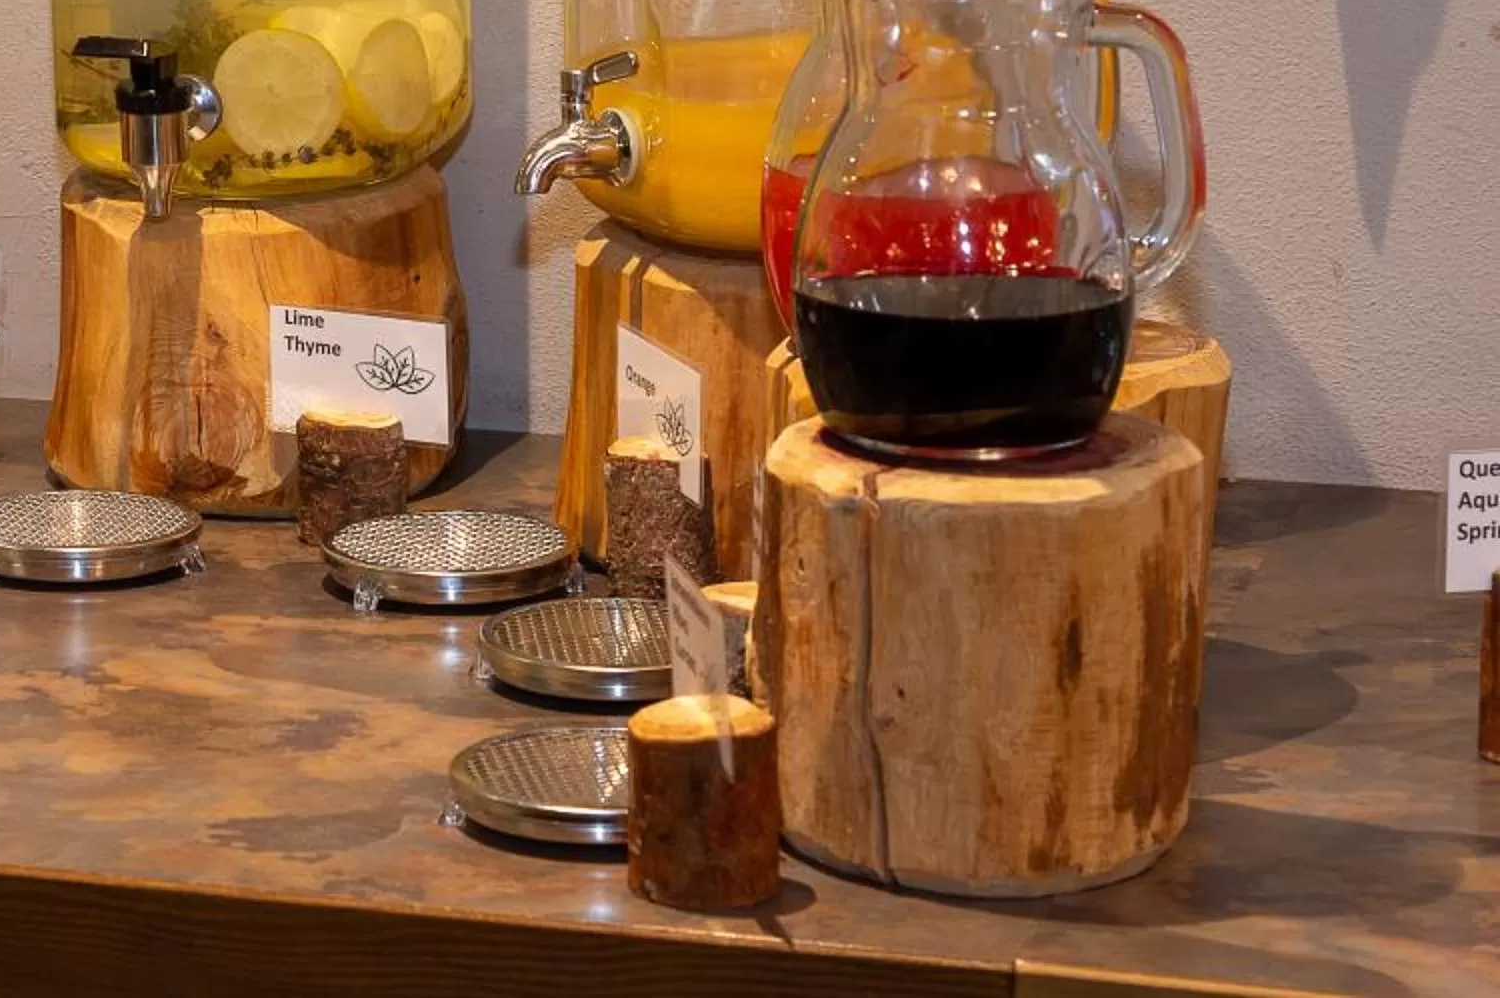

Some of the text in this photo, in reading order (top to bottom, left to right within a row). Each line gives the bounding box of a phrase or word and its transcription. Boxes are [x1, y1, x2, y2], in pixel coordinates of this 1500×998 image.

[284, 309, 325, 329] Lime
[283, 335, 341, 357] Thyme
[1457, 491, 1500, 513] Aqu
[1456, 521, 1500, 545] Spri
